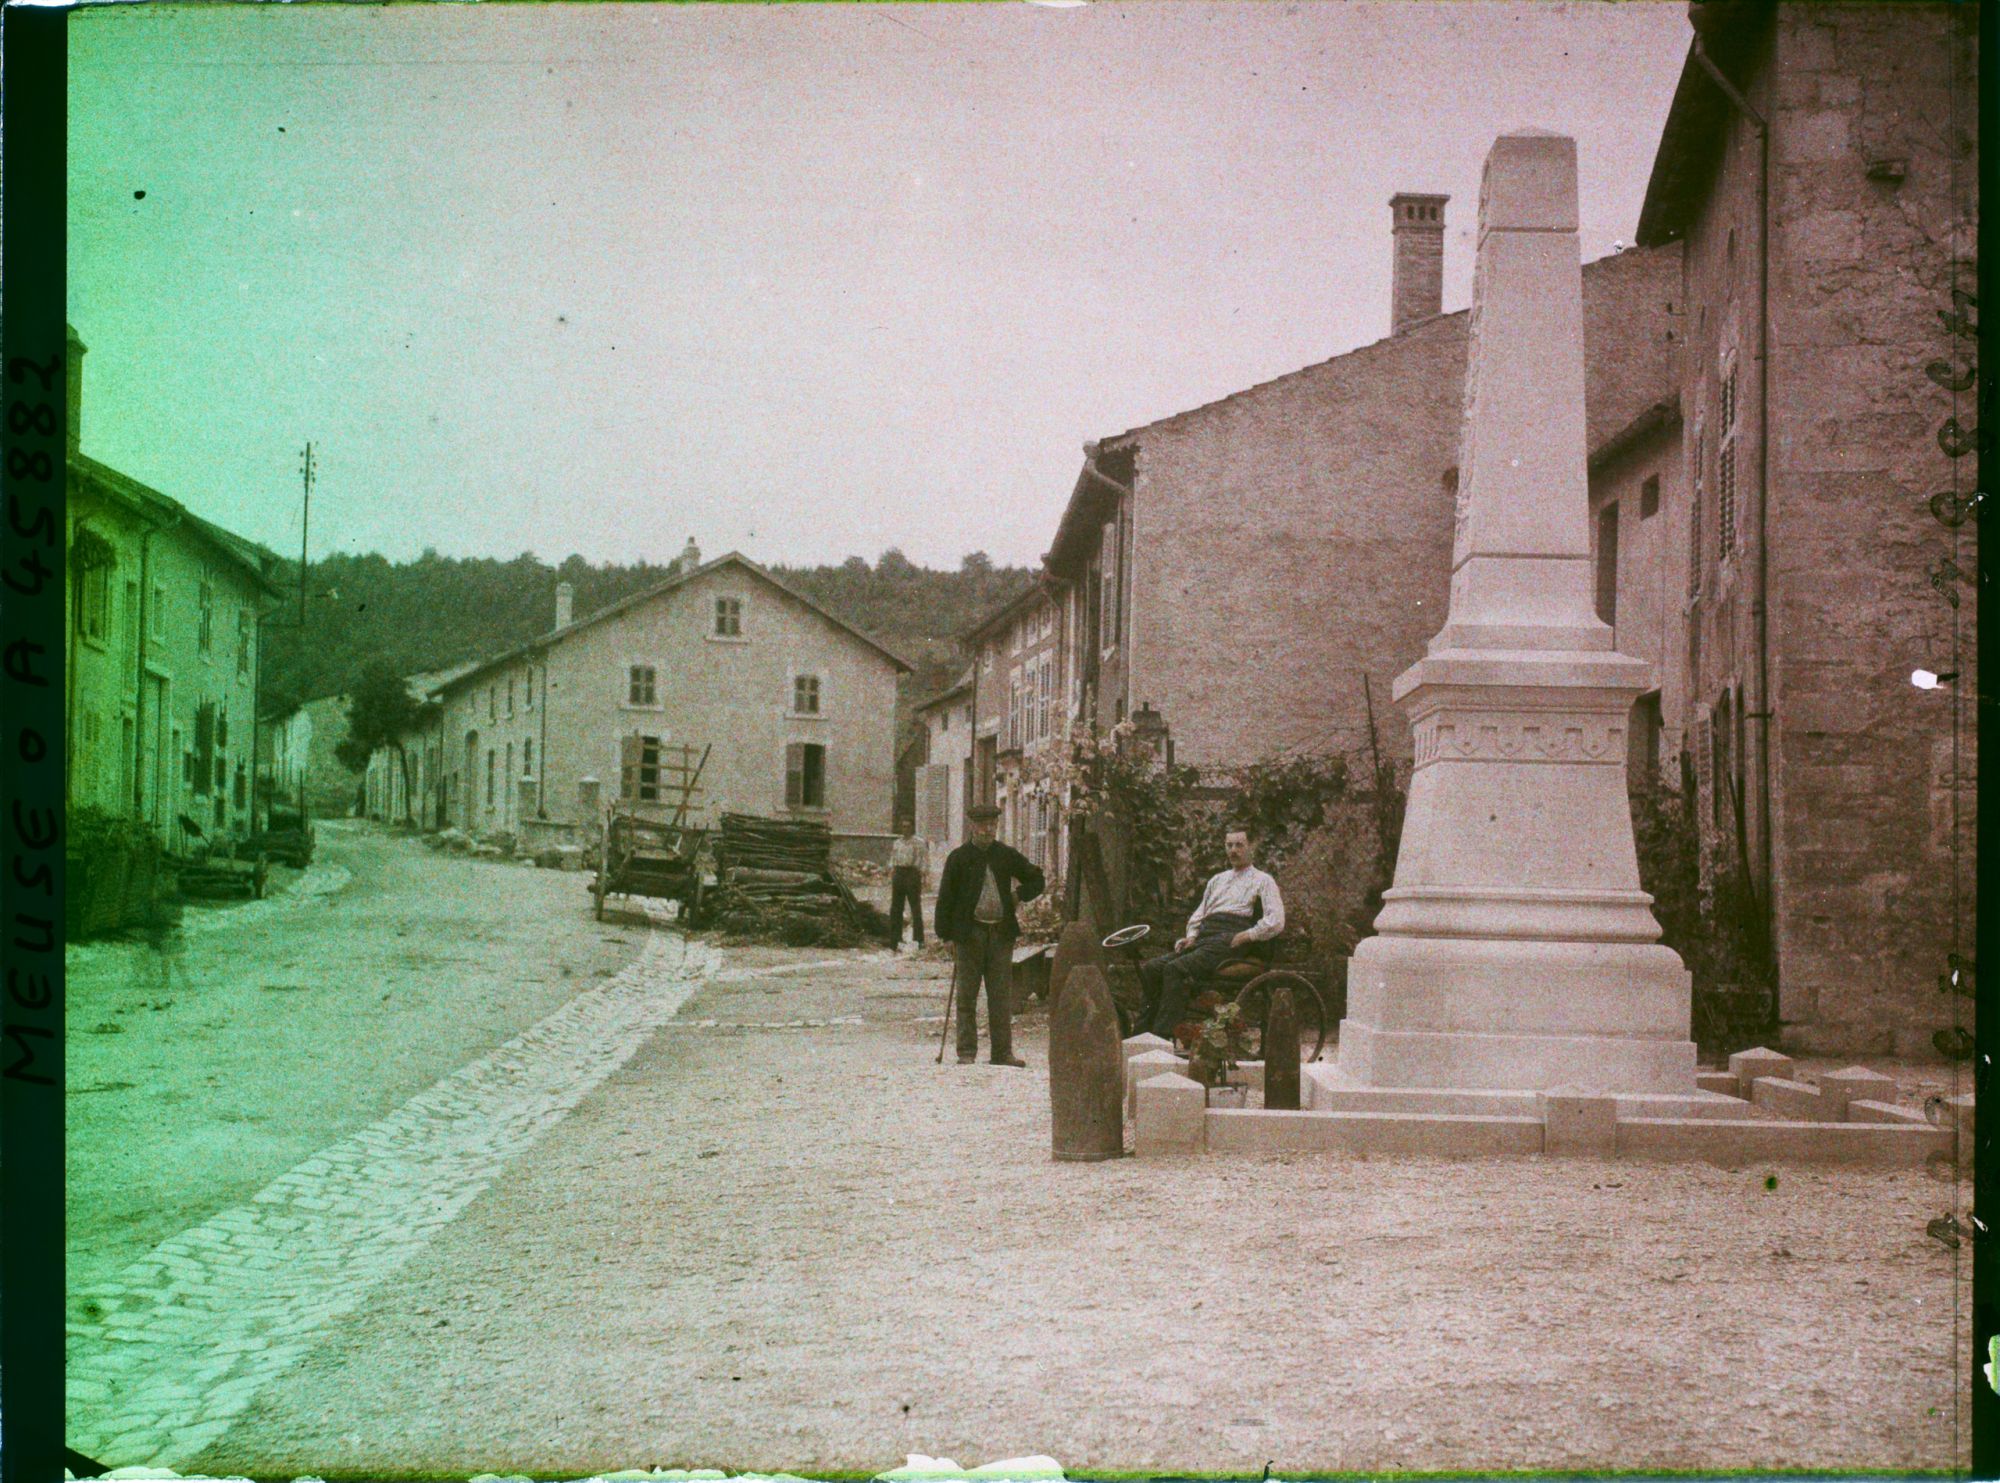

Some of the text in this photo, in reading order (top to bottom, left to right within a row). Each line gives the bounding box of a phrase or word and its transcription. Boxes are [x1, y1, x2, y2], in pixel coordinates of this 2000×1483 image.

[1, 354, 61, 597] 45882
[2, 636, 50, 688] A
[3, 798, 59, 1087] MEUSE
